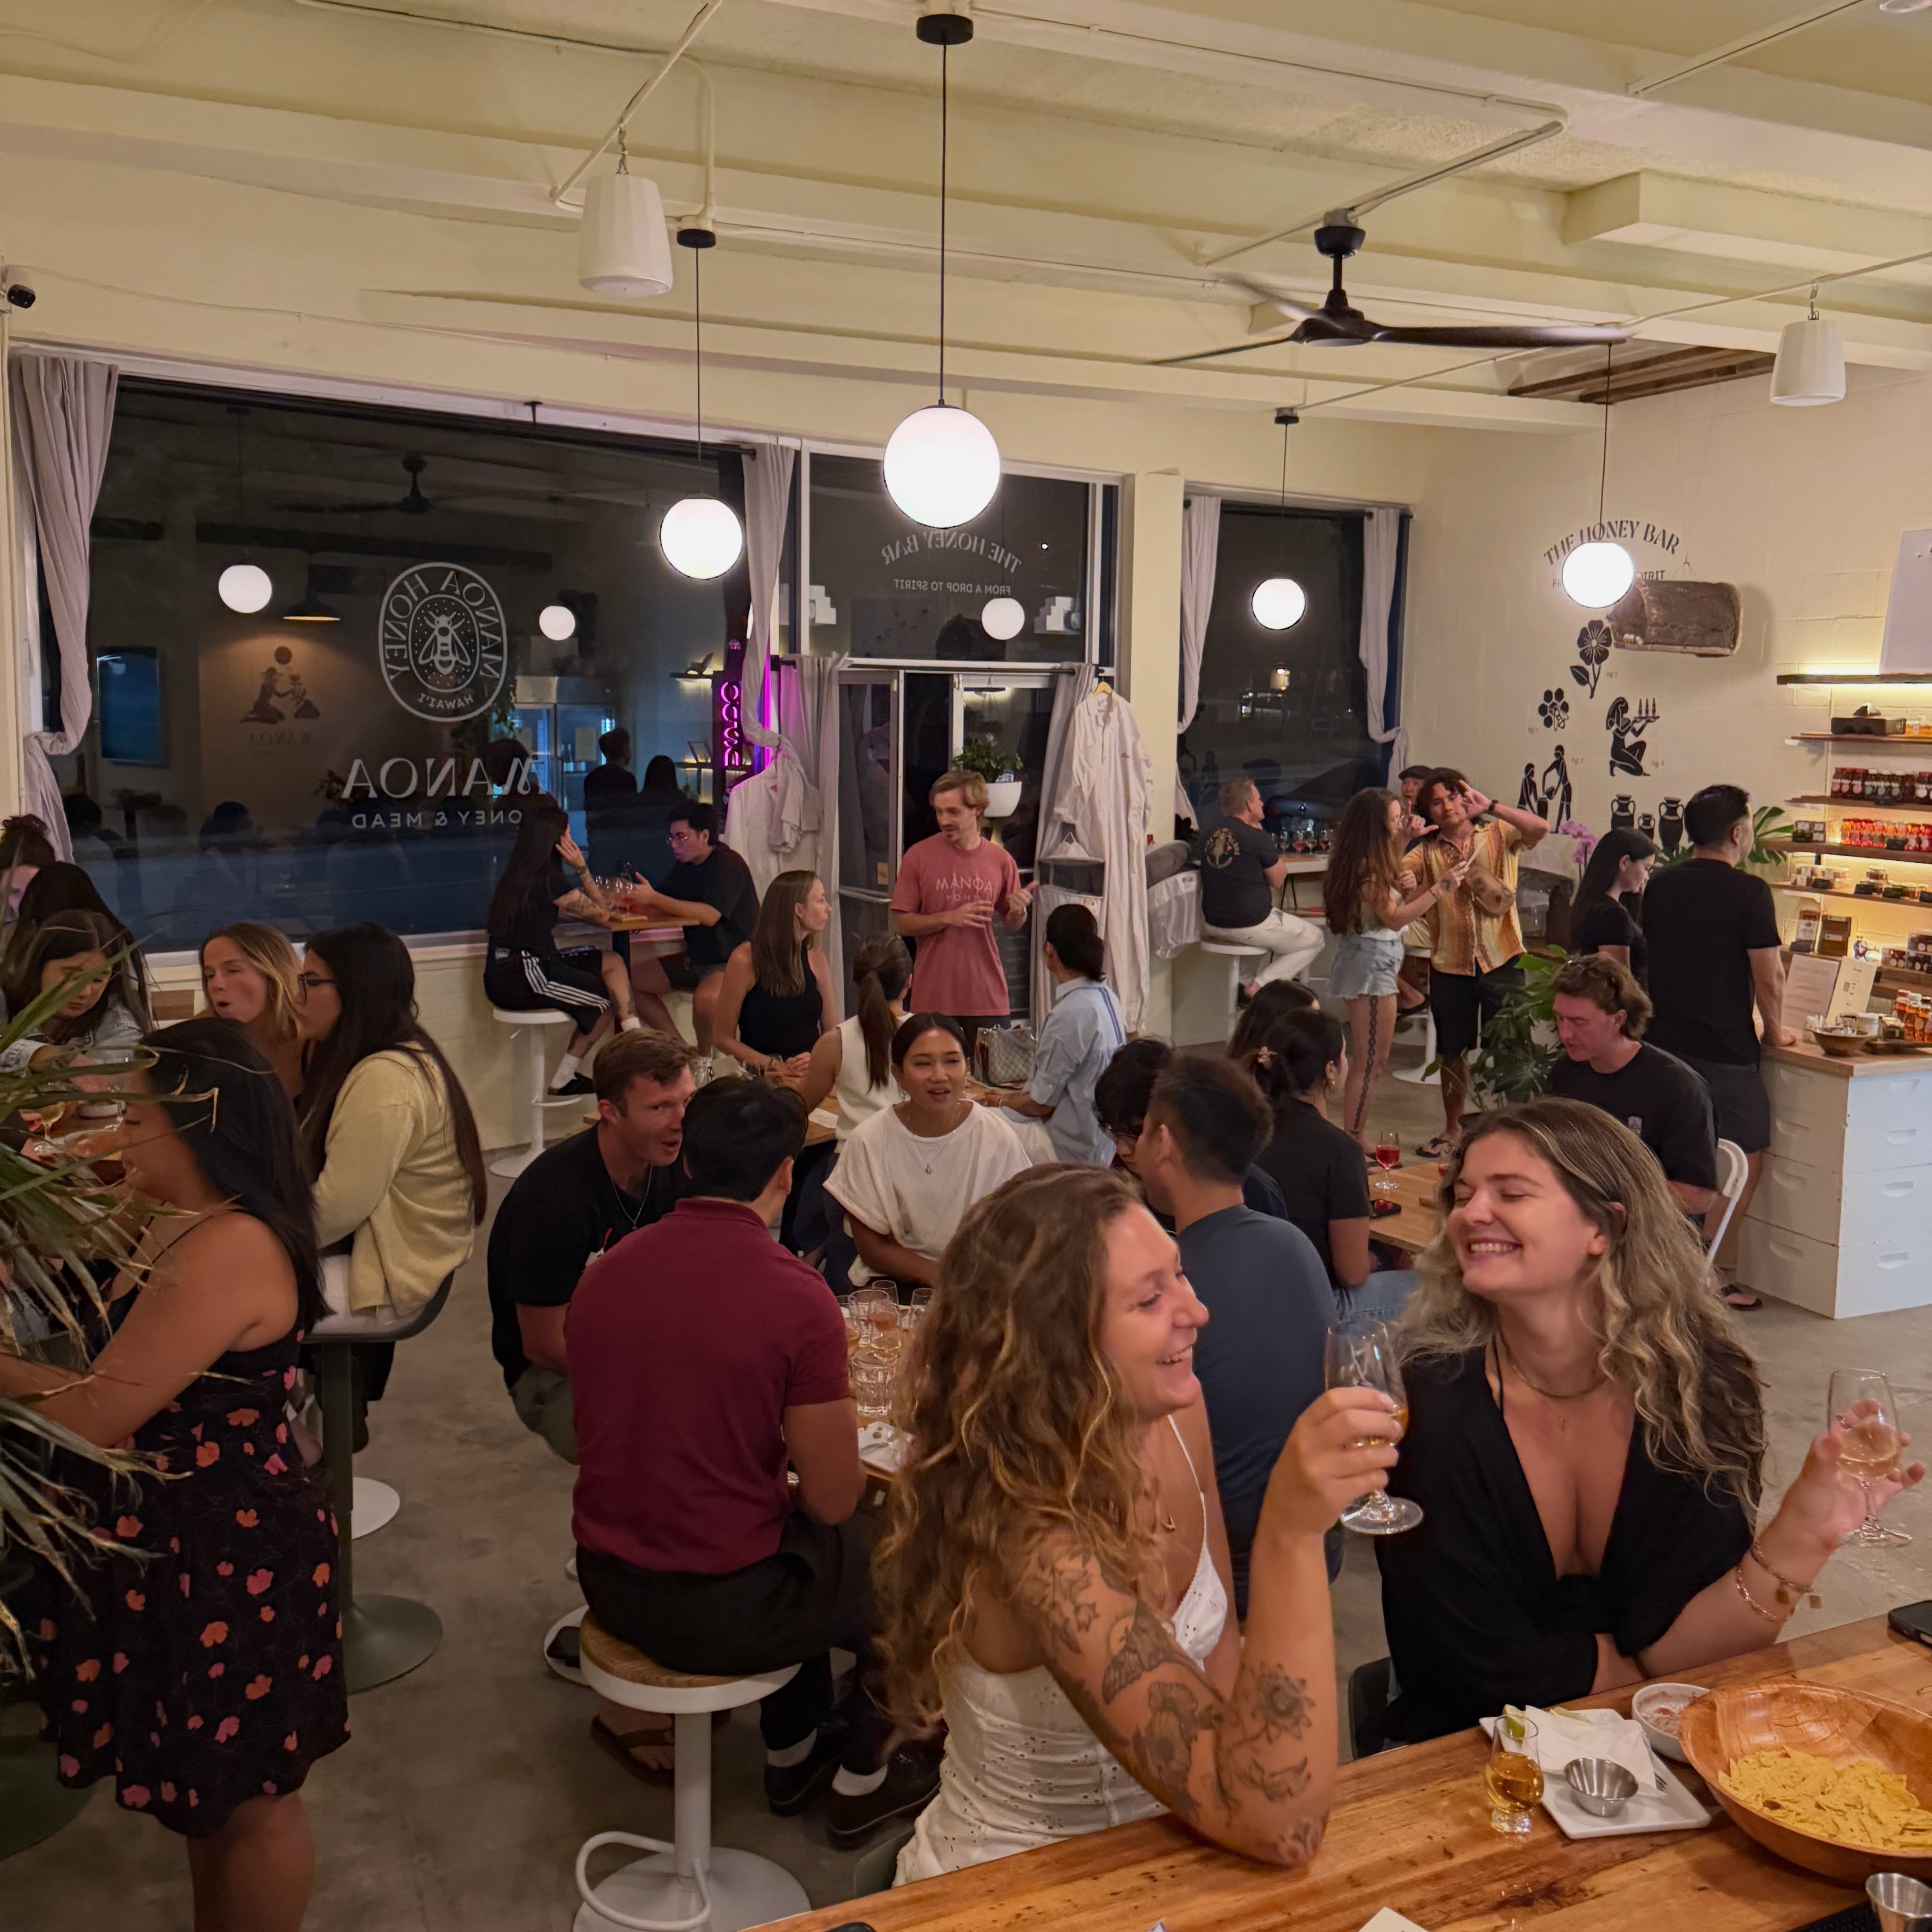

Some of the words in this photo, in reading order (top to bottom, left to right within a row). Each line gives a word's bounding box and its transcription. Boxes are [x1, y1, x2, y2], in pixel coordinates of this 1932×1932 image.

[1544, 534, 1573, 566] THE
[1580, 520, 1639, 543] HONEY
[1643, 523, 1679, 555] BAR
